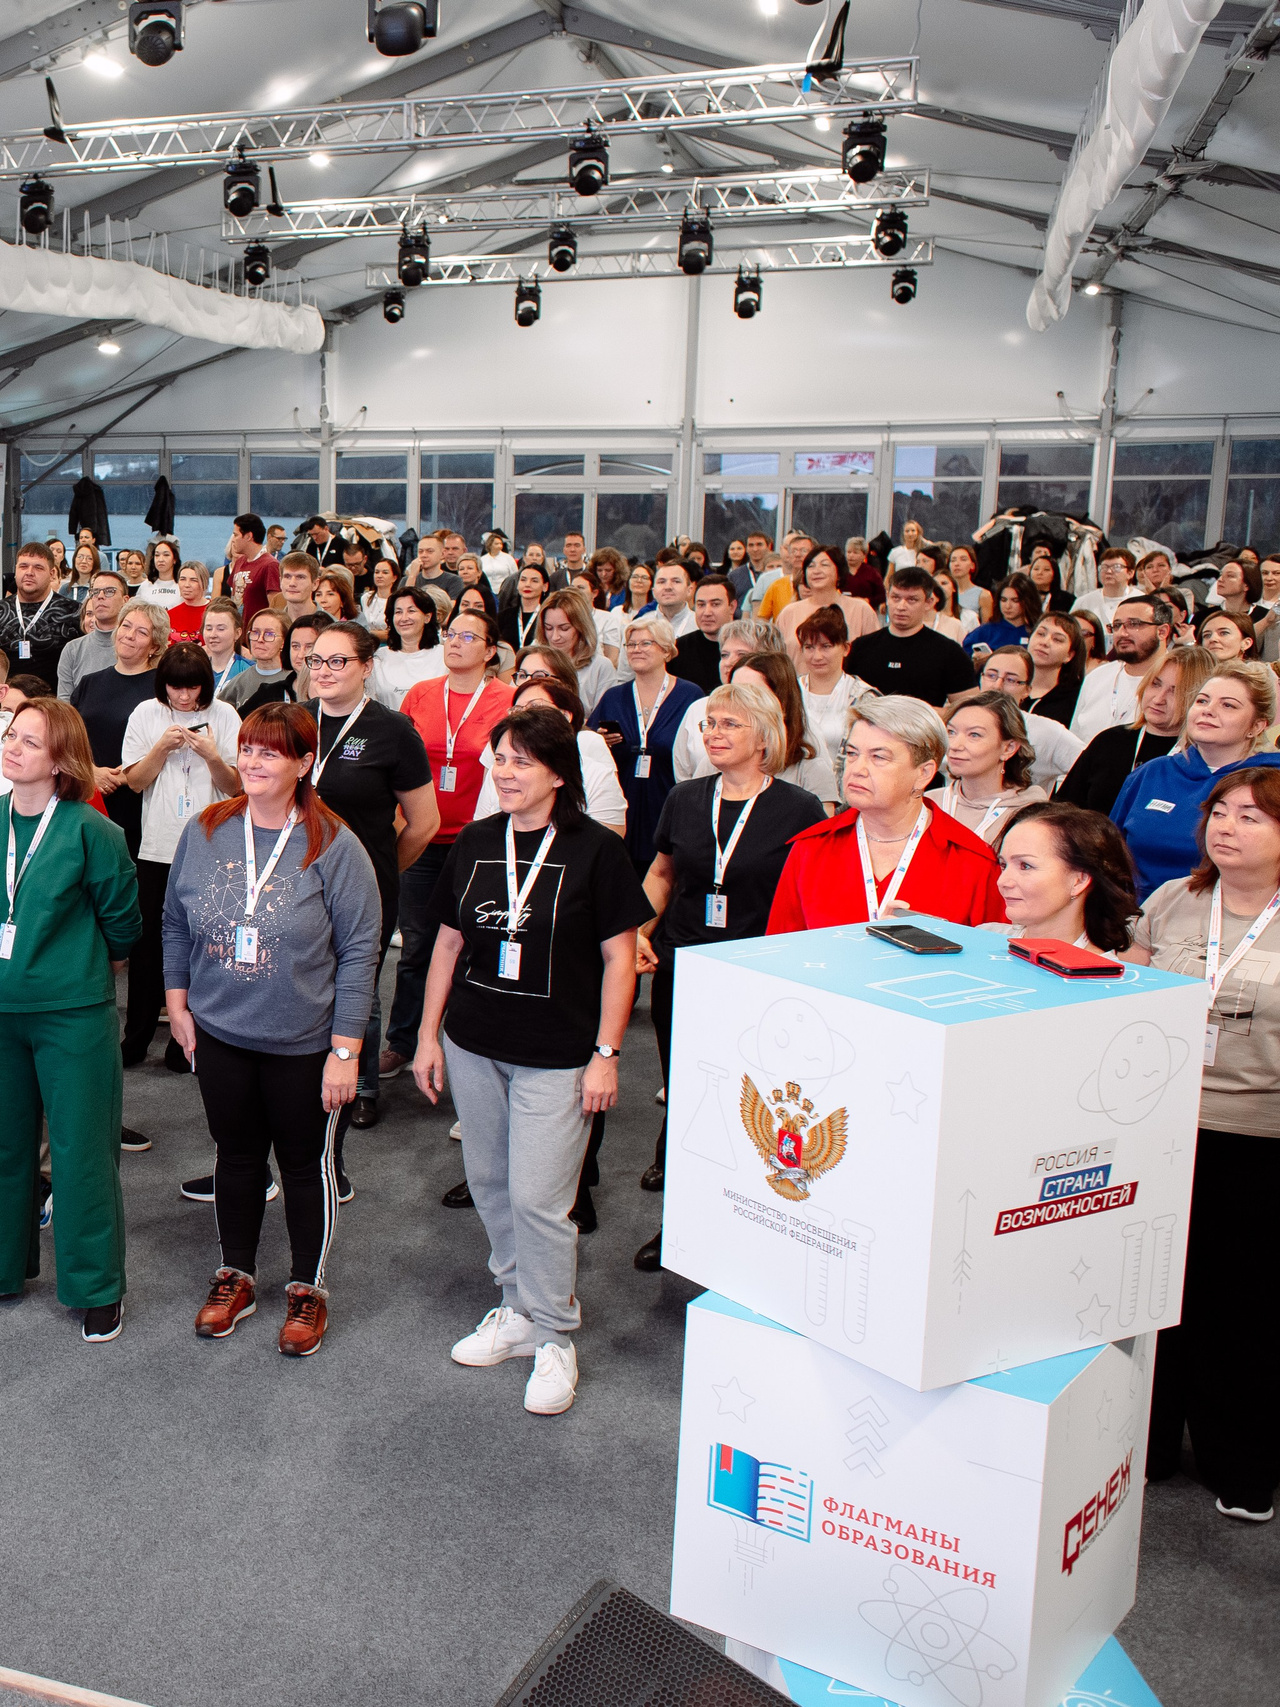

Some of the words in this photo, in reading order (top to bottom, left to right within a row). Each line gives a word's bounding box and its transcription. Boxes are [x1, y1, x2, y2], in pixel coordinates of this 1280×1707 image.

[343, 750, 361, 758] DAY
[213, 931, 223, 941] to
[208, 943, 272, 964] mon
[235, 961, 260, 975] back
[499, 942, 507, 973] УЧАСТНИК
[1034, 1146, 1098, 1174] РОССИЯ
[1043, 1170, 1104, 1197] СТРАНА
[723, 1188, 787, 1223] МИНИСТЕРСТВО
[789, 1215, 857, 1251] ПРОСВЕЩЕНИЯ
[999, 1184, 1132, 1231] ВОЗМОЖНОСТЕЙ
[733, 1205, 787, 1236] РОССИЙСКОЙ
[789, 1229, 843, 1259] ФЕДЕРАЦИИ
[822, 1496, 961, 1553] ФЛАГМАНЫ
[1061, 1446, 1132, 1577] СЕНЕЖ
[821, 1519, 997, 1589] ОБРАЗОВАНИЯ
